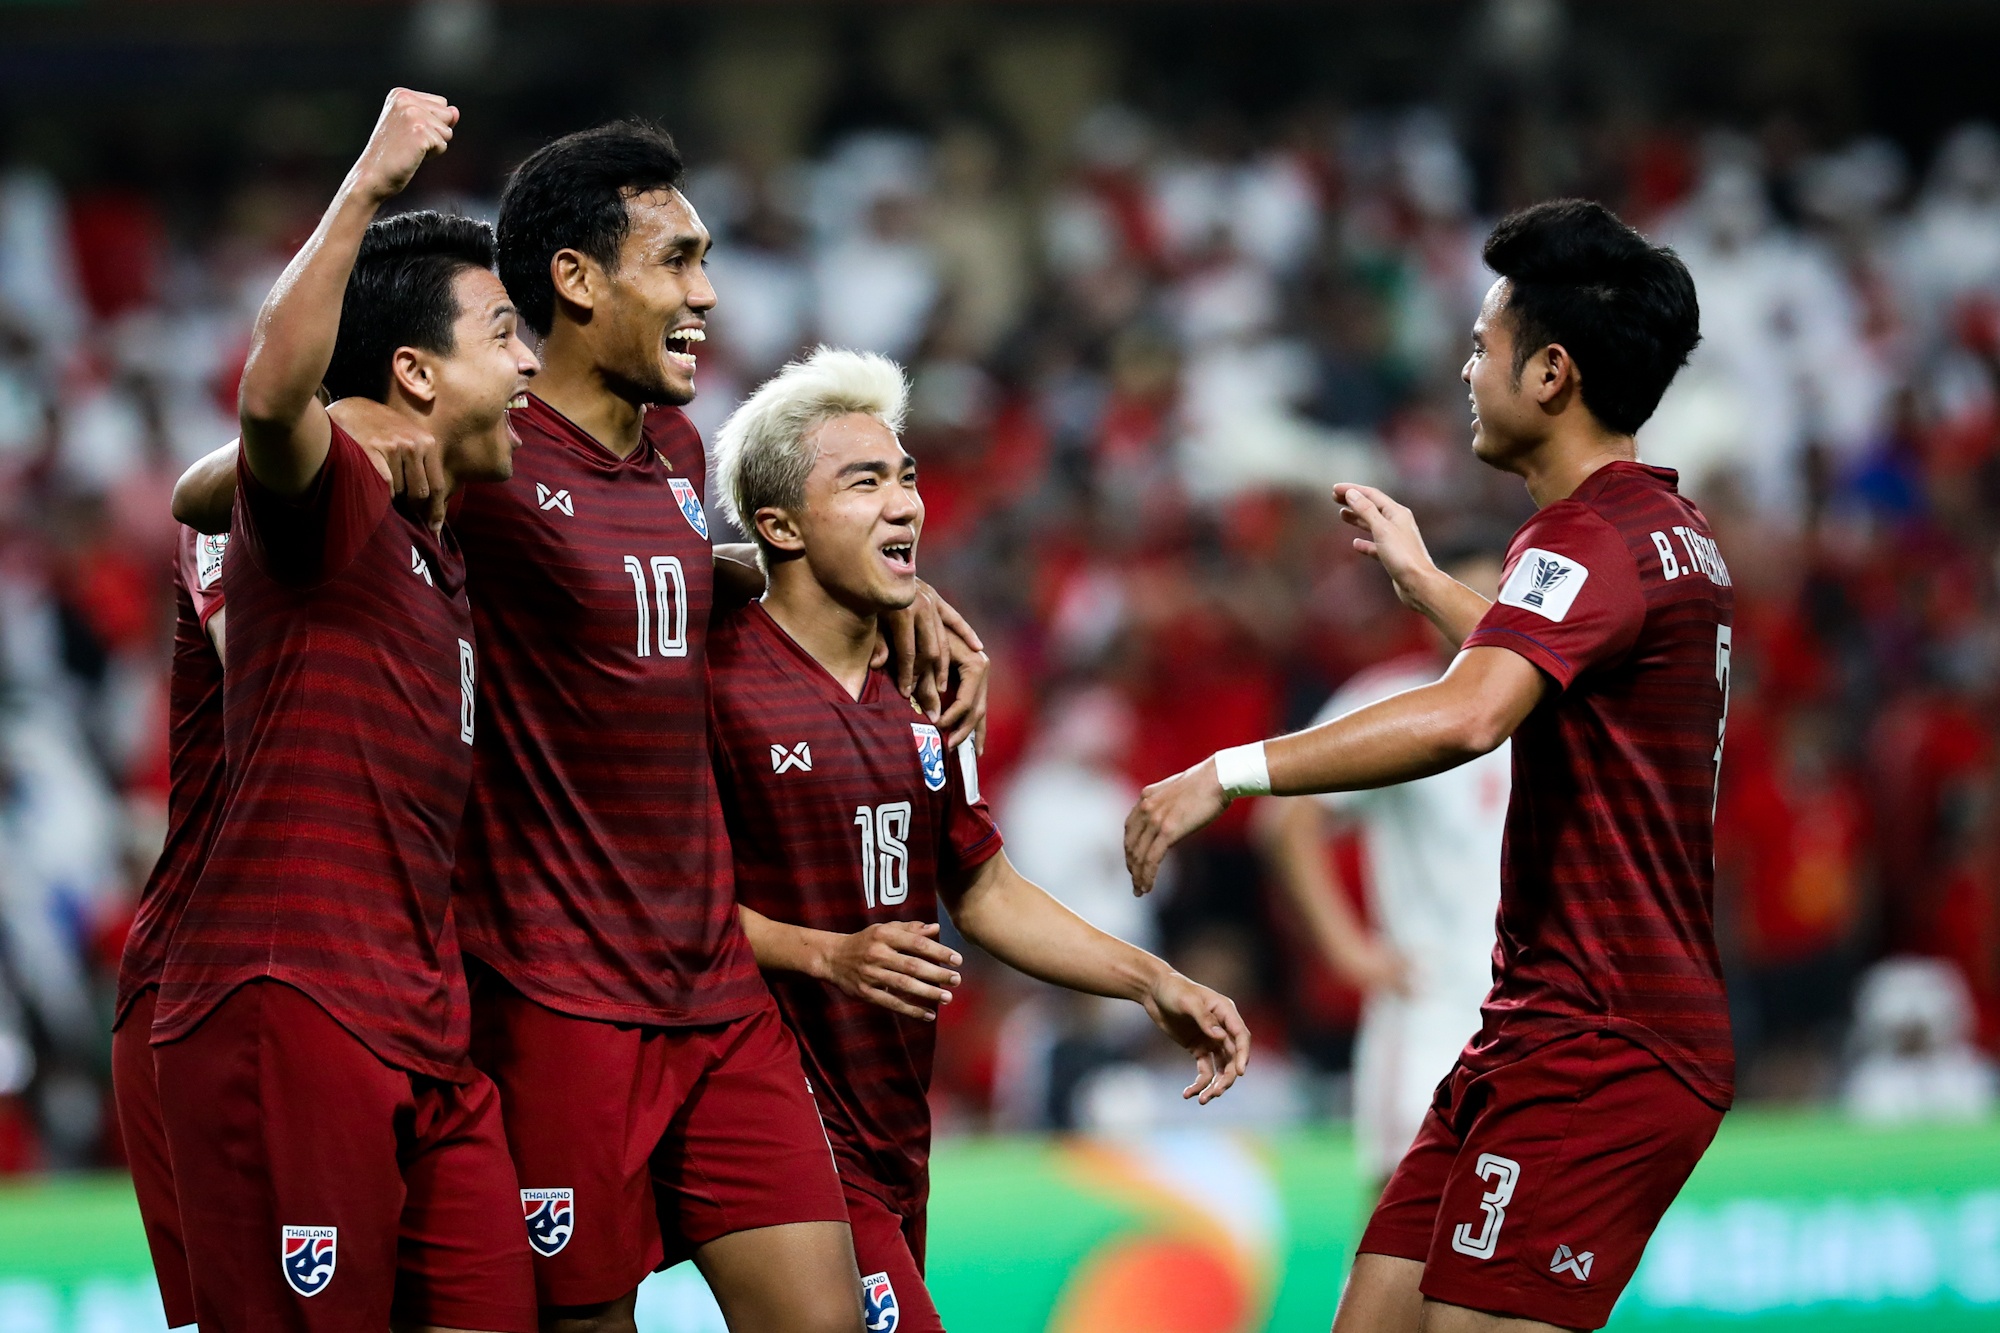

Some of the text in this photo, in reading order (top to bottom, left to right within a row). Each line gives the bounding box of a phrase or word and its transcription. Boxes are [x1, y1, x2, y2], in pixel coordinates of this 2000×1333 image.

[202, 562, 221, 577] ASIA
[623, 555, 688, 657] 10
[458, 638, 475, 746] 8
[854, 801, 911, 909] 18
[524, 1191, 571, 1199] THAILAND
[1452, 1153, 1520, 1260] 3
[286, 1229, 333, 1237] THAILAND
[862, 1275, 886, 1288] LAND
